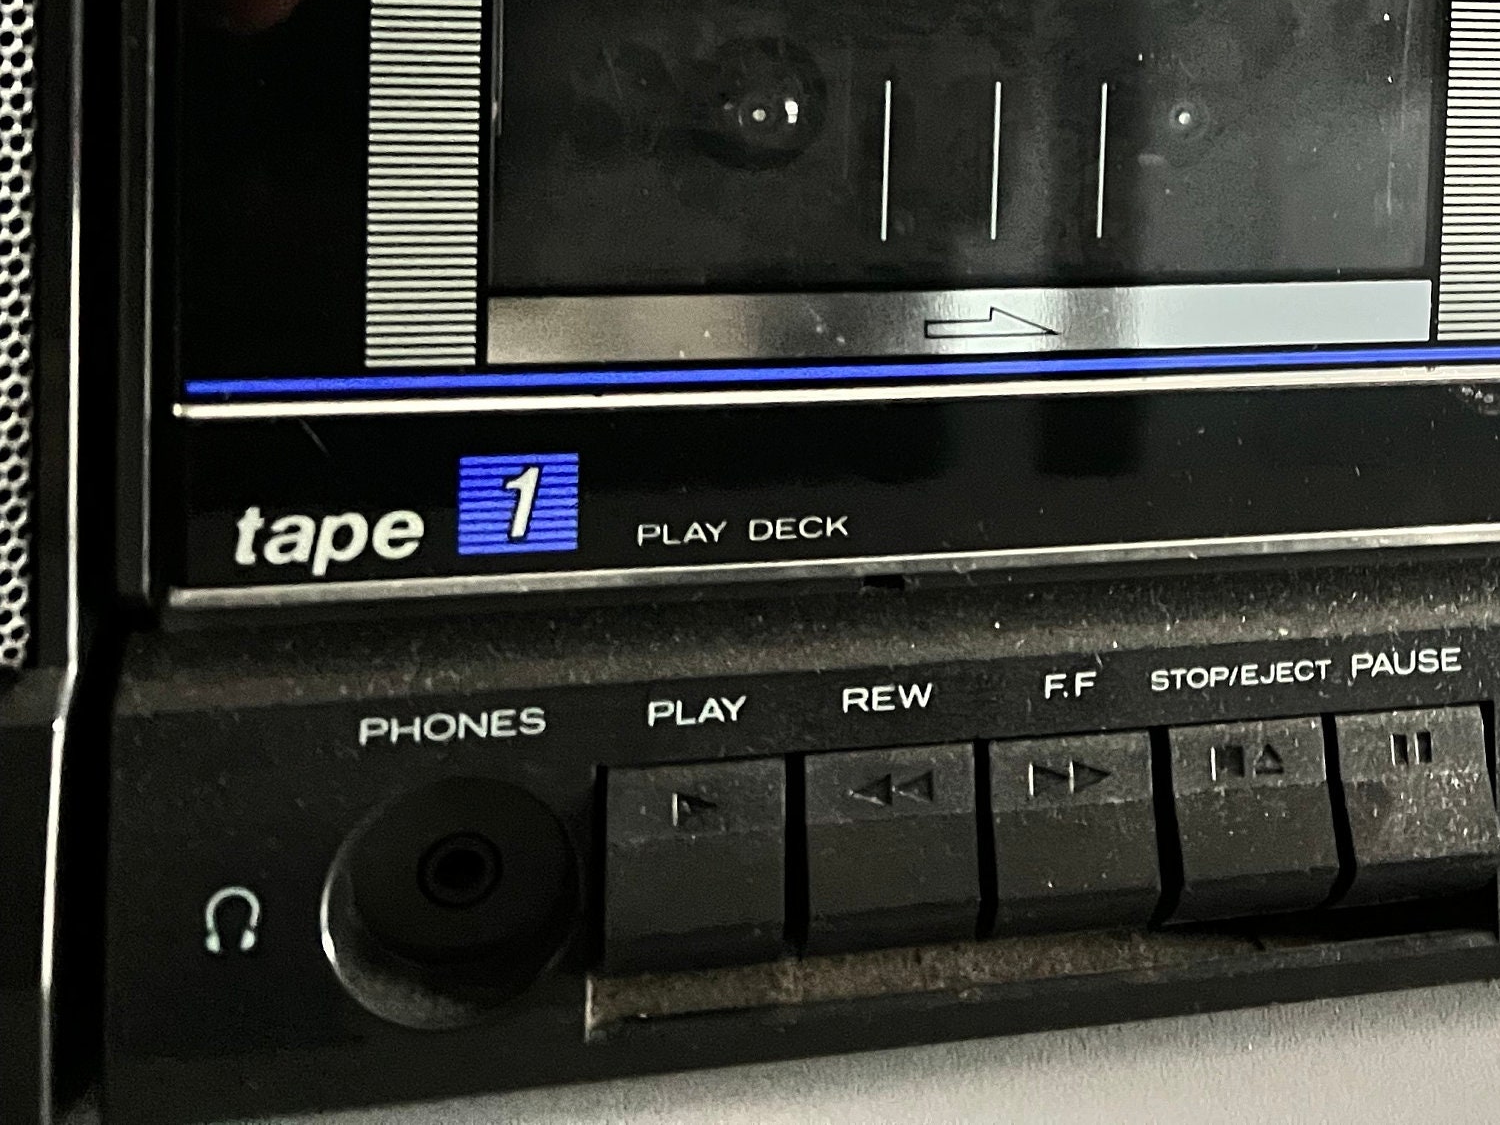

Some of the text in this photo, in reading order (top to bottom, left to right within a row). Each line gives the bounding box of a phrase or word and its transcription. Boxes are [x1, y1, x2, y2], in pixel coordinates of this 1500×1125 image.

[235, 467, 849, 576] tape 1 PLAY DECK
[1150, 658, 1331, 693] STOP/EJECT
[1350, 647, 1462, 678] PAUSE
[842, 681, 933, 713] REW
[1044, 671, 1097, 699] F.F
[358, 707, 547, 746] PHONES
[648, 695, 747, 727] PLAY
